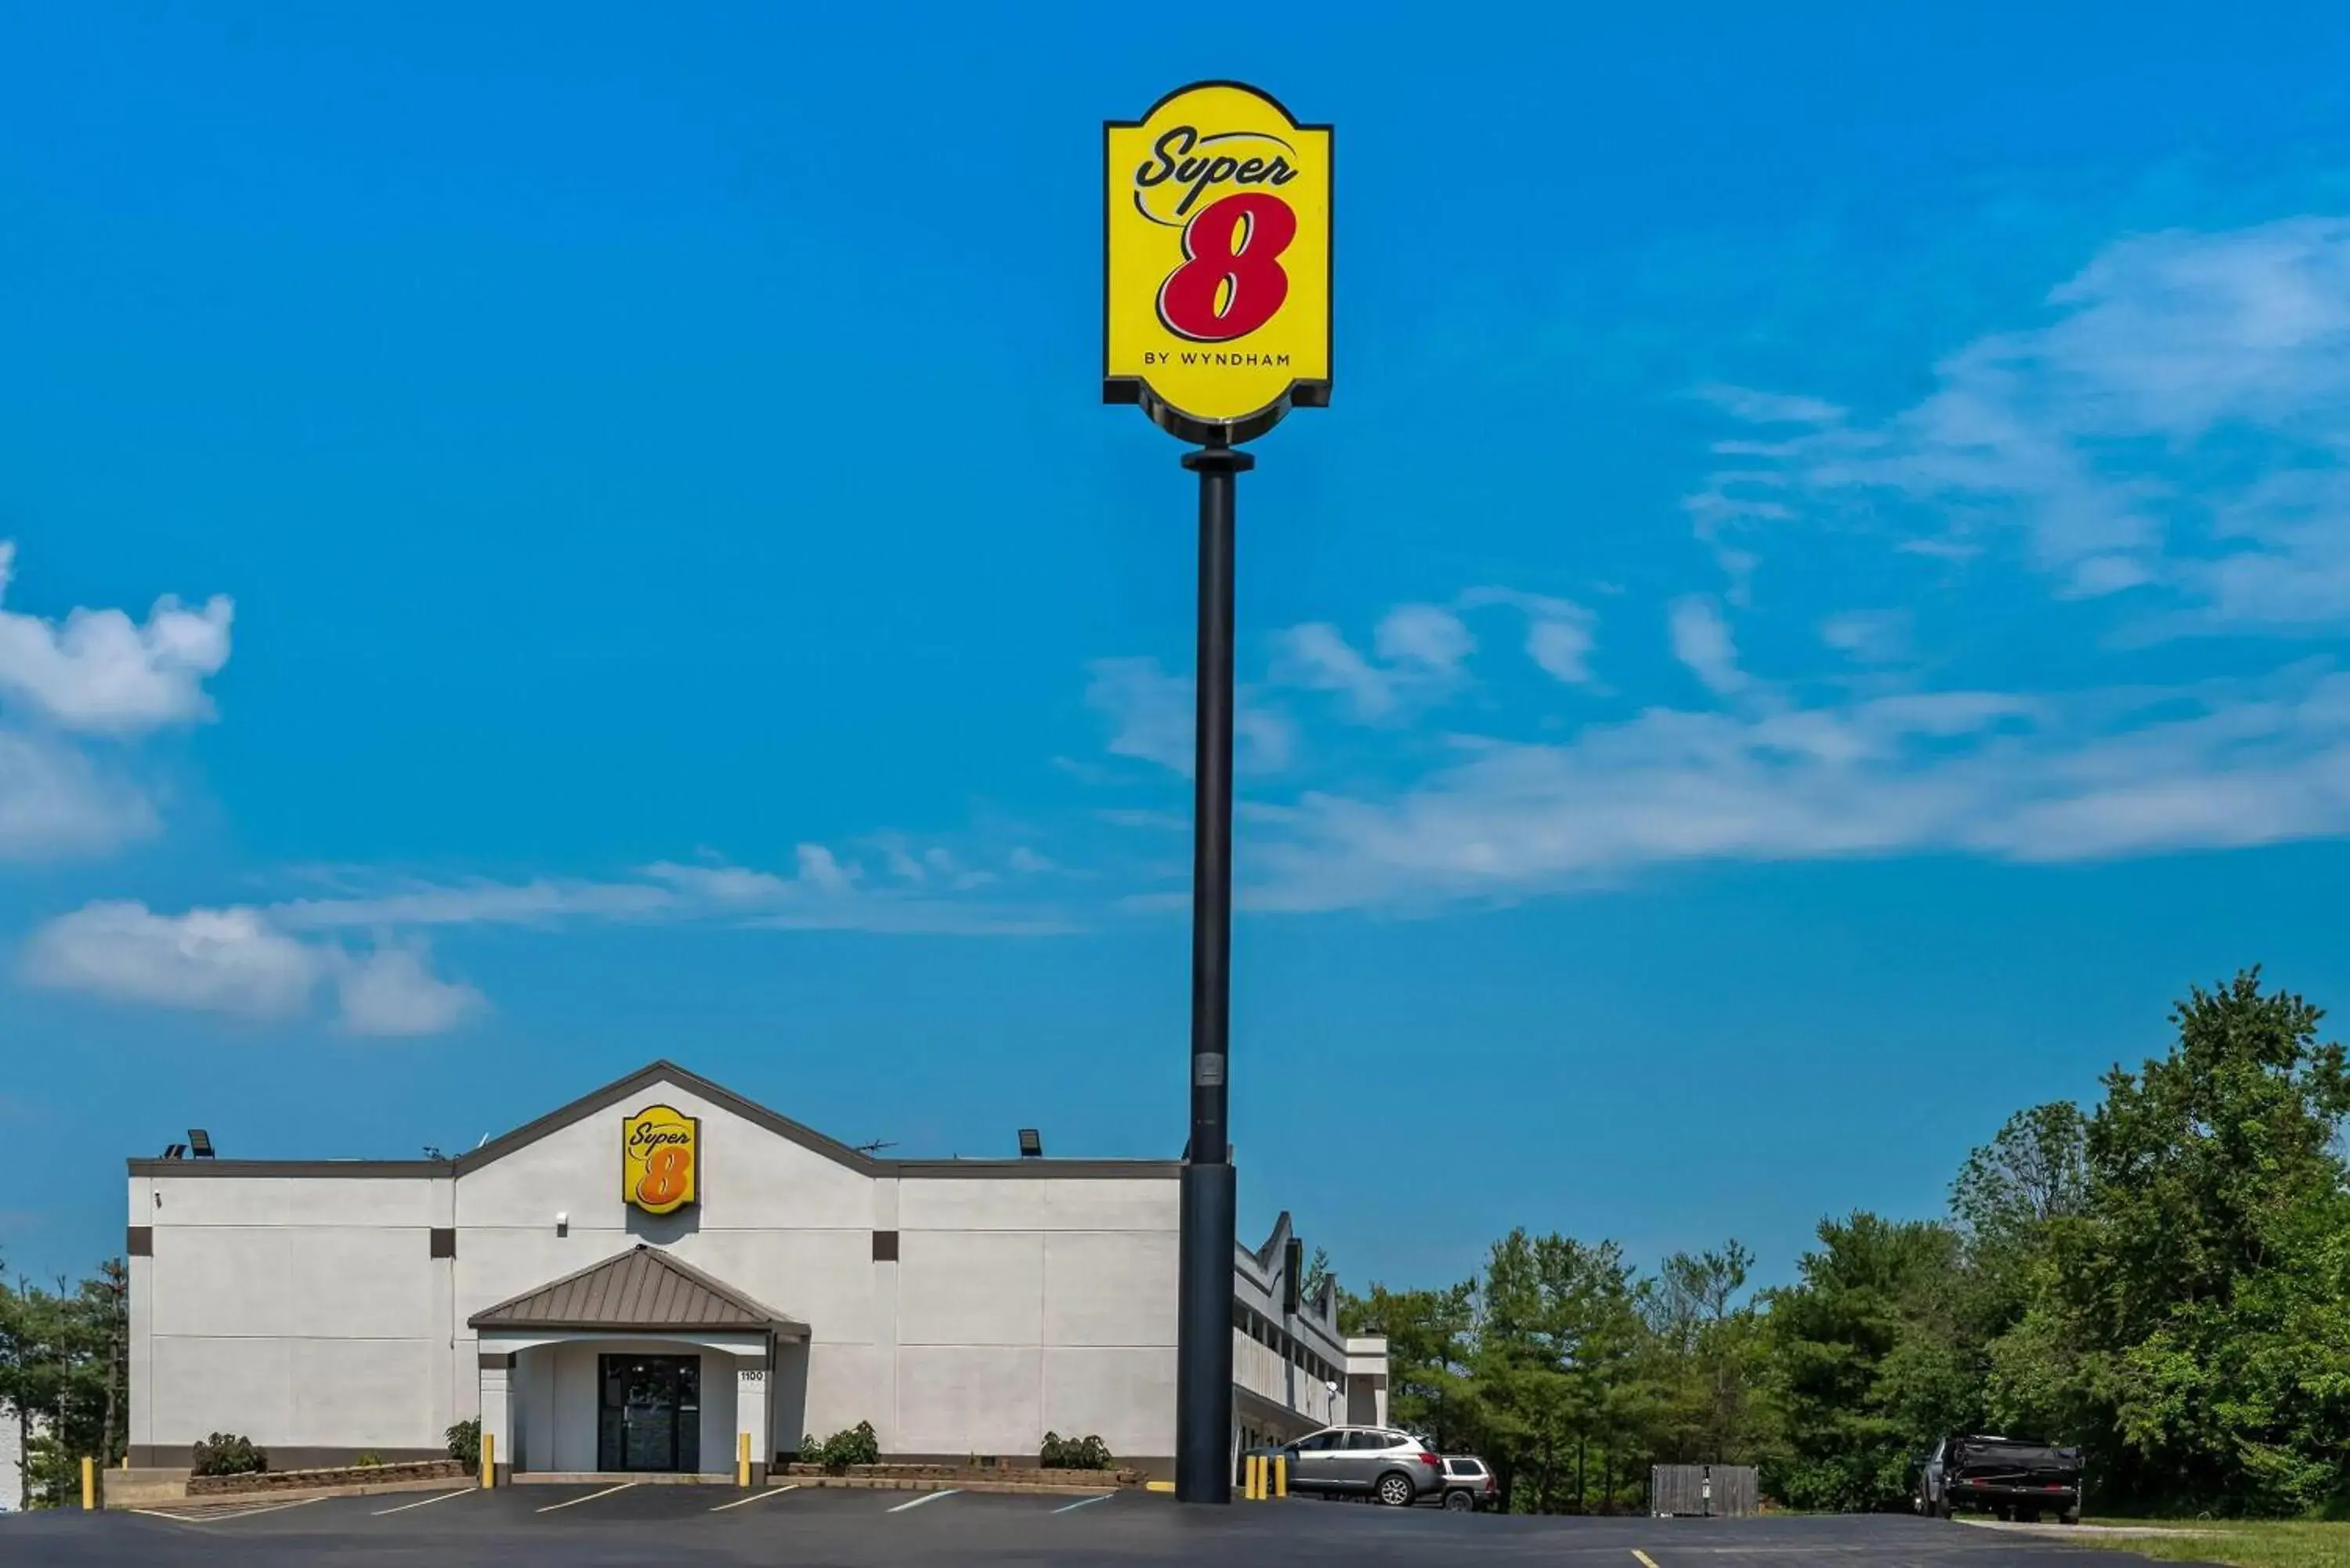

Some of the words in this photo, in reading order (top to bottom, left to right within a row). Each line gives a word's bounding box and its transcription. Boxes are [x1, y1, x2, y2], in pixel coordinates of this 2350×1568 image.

[1135, 125, 1299, 216] Super
[1155, 193, 1297, 343] 8
[1144, 352, 1171, 365] BY
[1180, 352, 1291, 367] WYNDHAM
[629, 1121, 690, 1156] Super
[636, 1147, 691, 1205] 8
[740, 1371, 764, 1381] 1100
